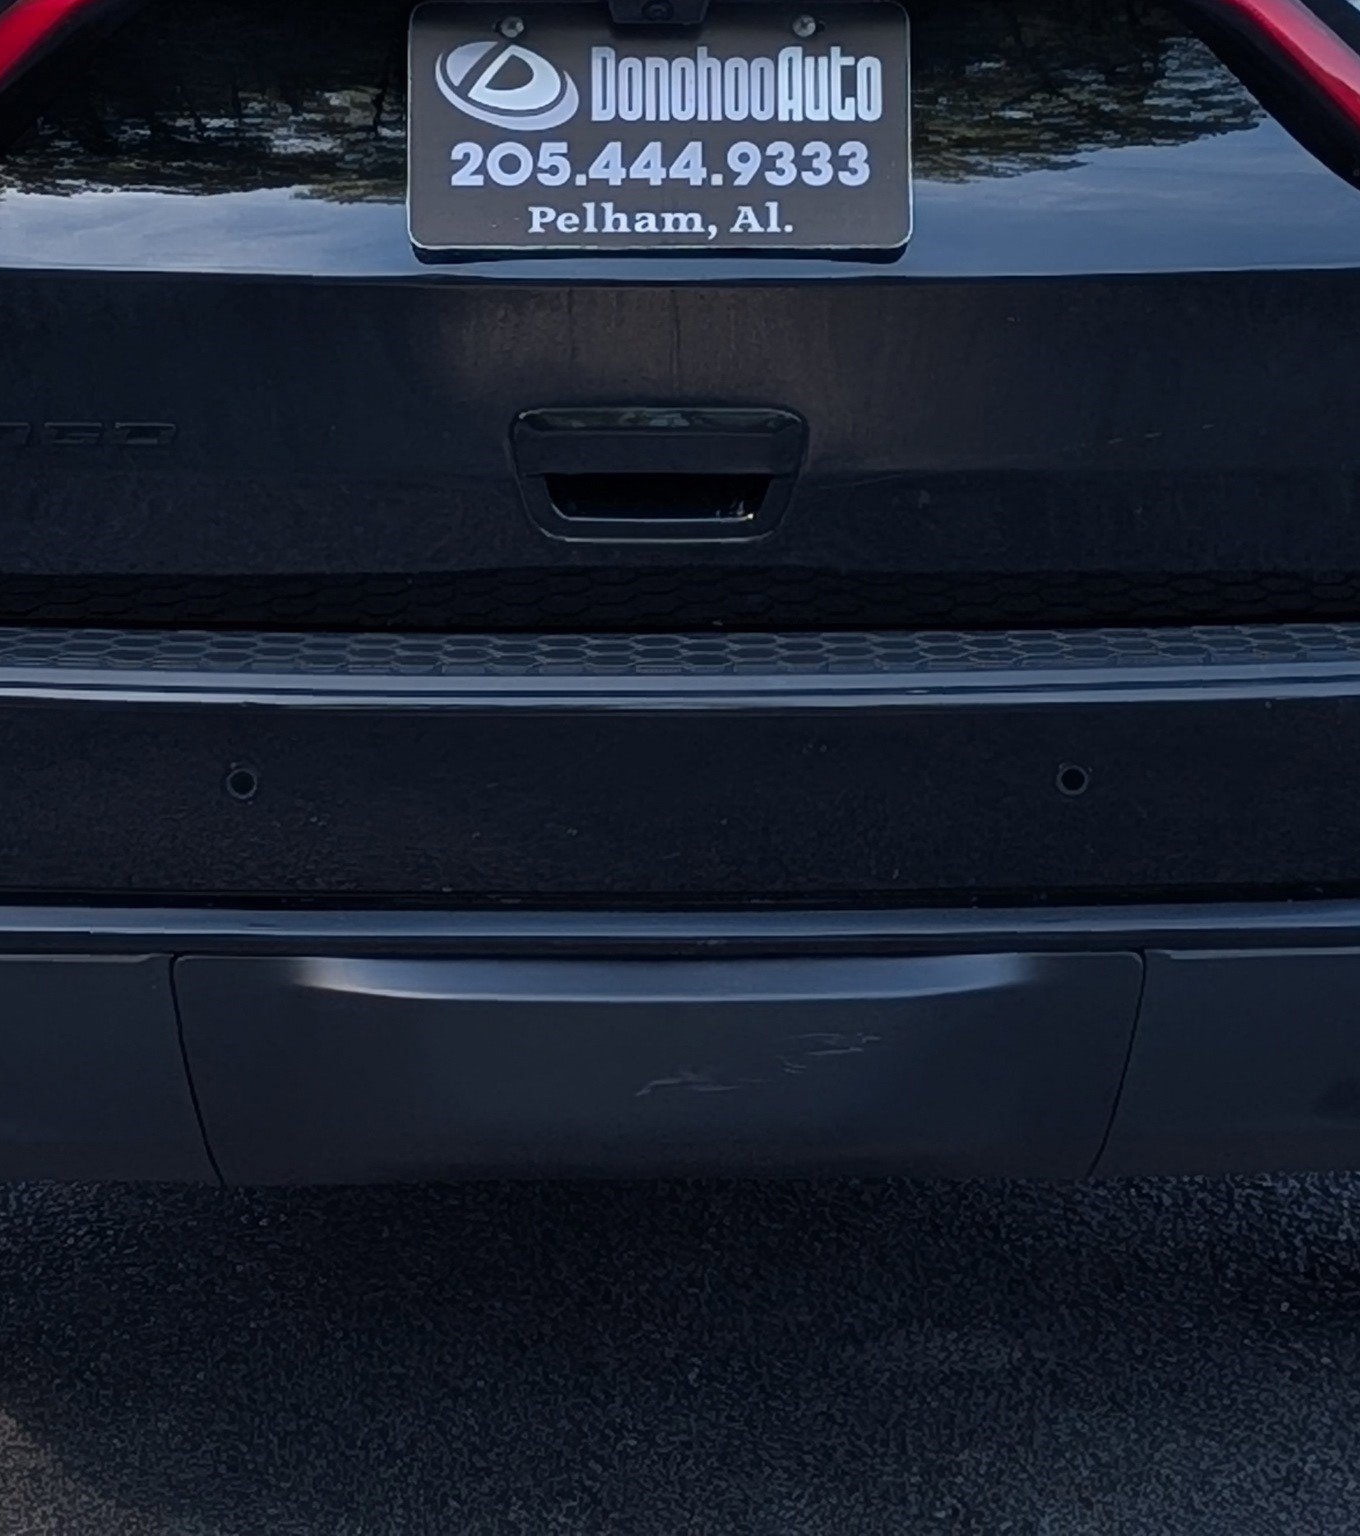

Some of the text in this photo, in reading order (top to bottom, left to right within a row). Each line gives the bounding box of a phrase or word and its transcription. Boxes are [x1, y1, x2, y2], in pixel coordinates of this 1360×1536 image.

[590, 45, 883, 122] DonohooAuto
[449, 140, 871, 187] 205.444.9333
[527, 202, 794, 240] Pelham, Al.
